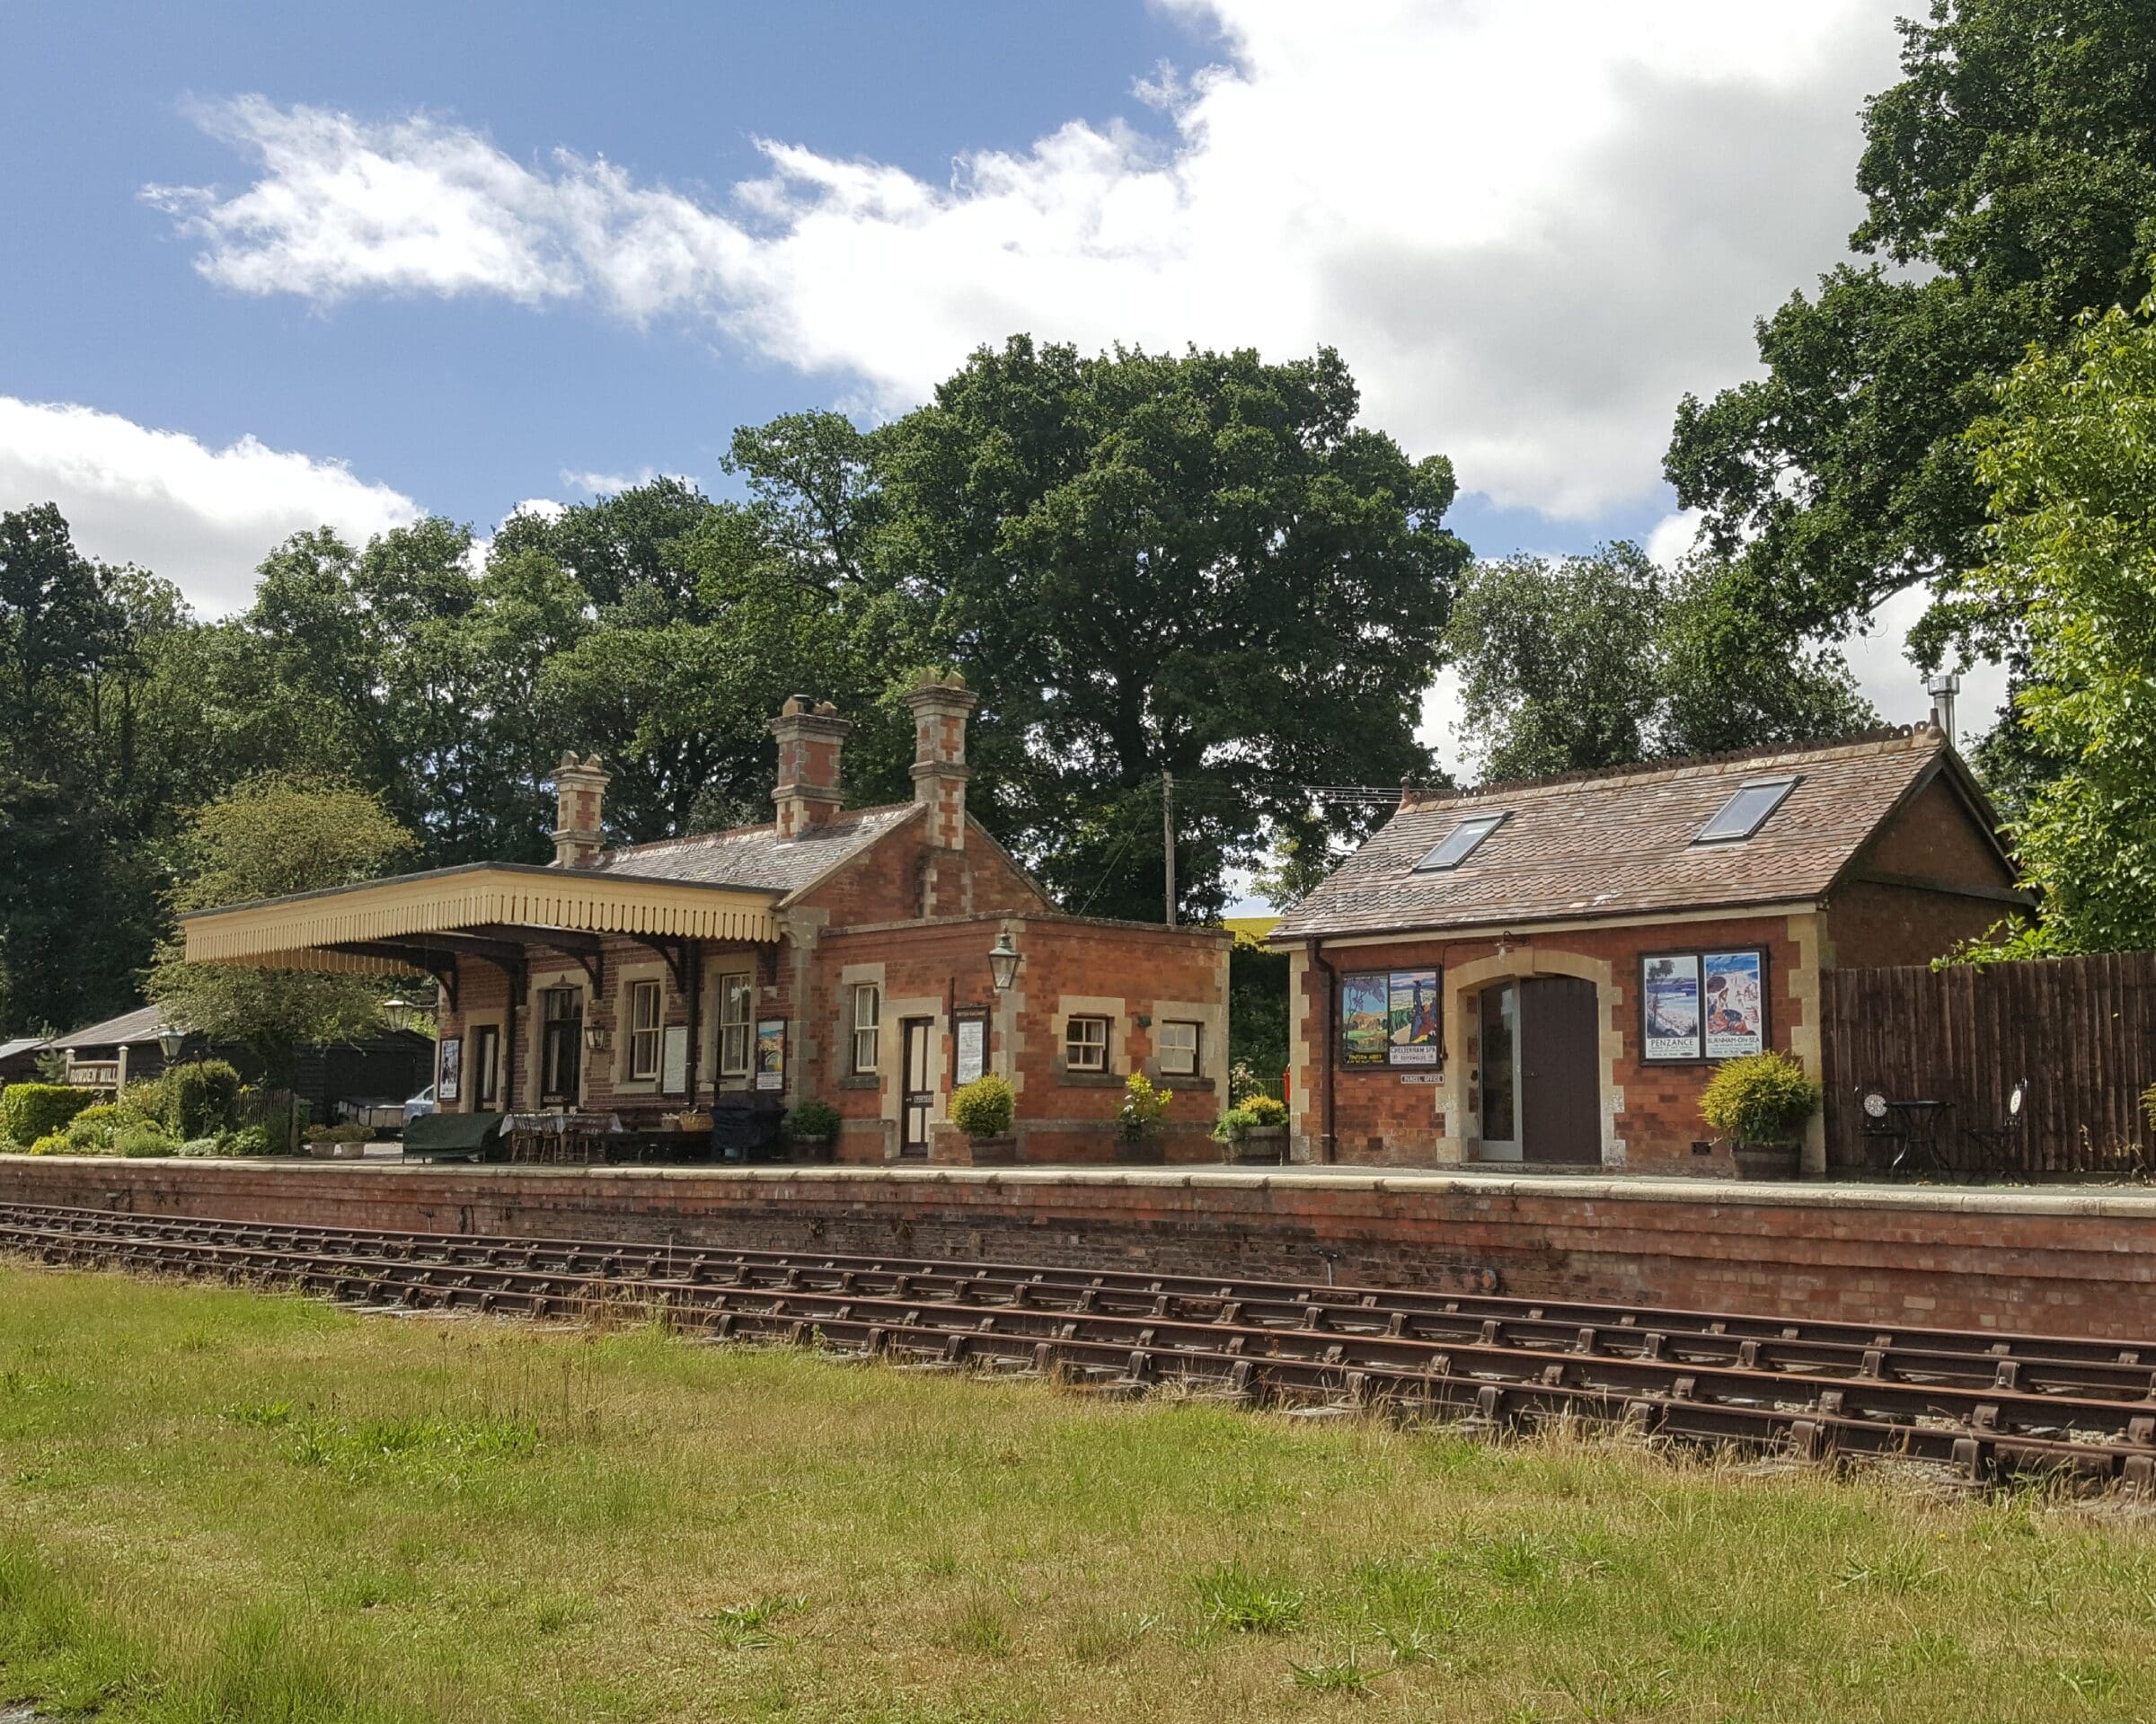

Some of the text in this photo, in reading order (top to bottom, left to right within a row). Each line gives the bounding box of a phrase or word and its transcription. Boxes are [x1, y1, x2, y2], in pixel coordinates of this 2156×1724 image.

[1651, 1039, 1693, 1047] PENZANCE
[69, 1067, 117, 1083] ROWDEN MILL
